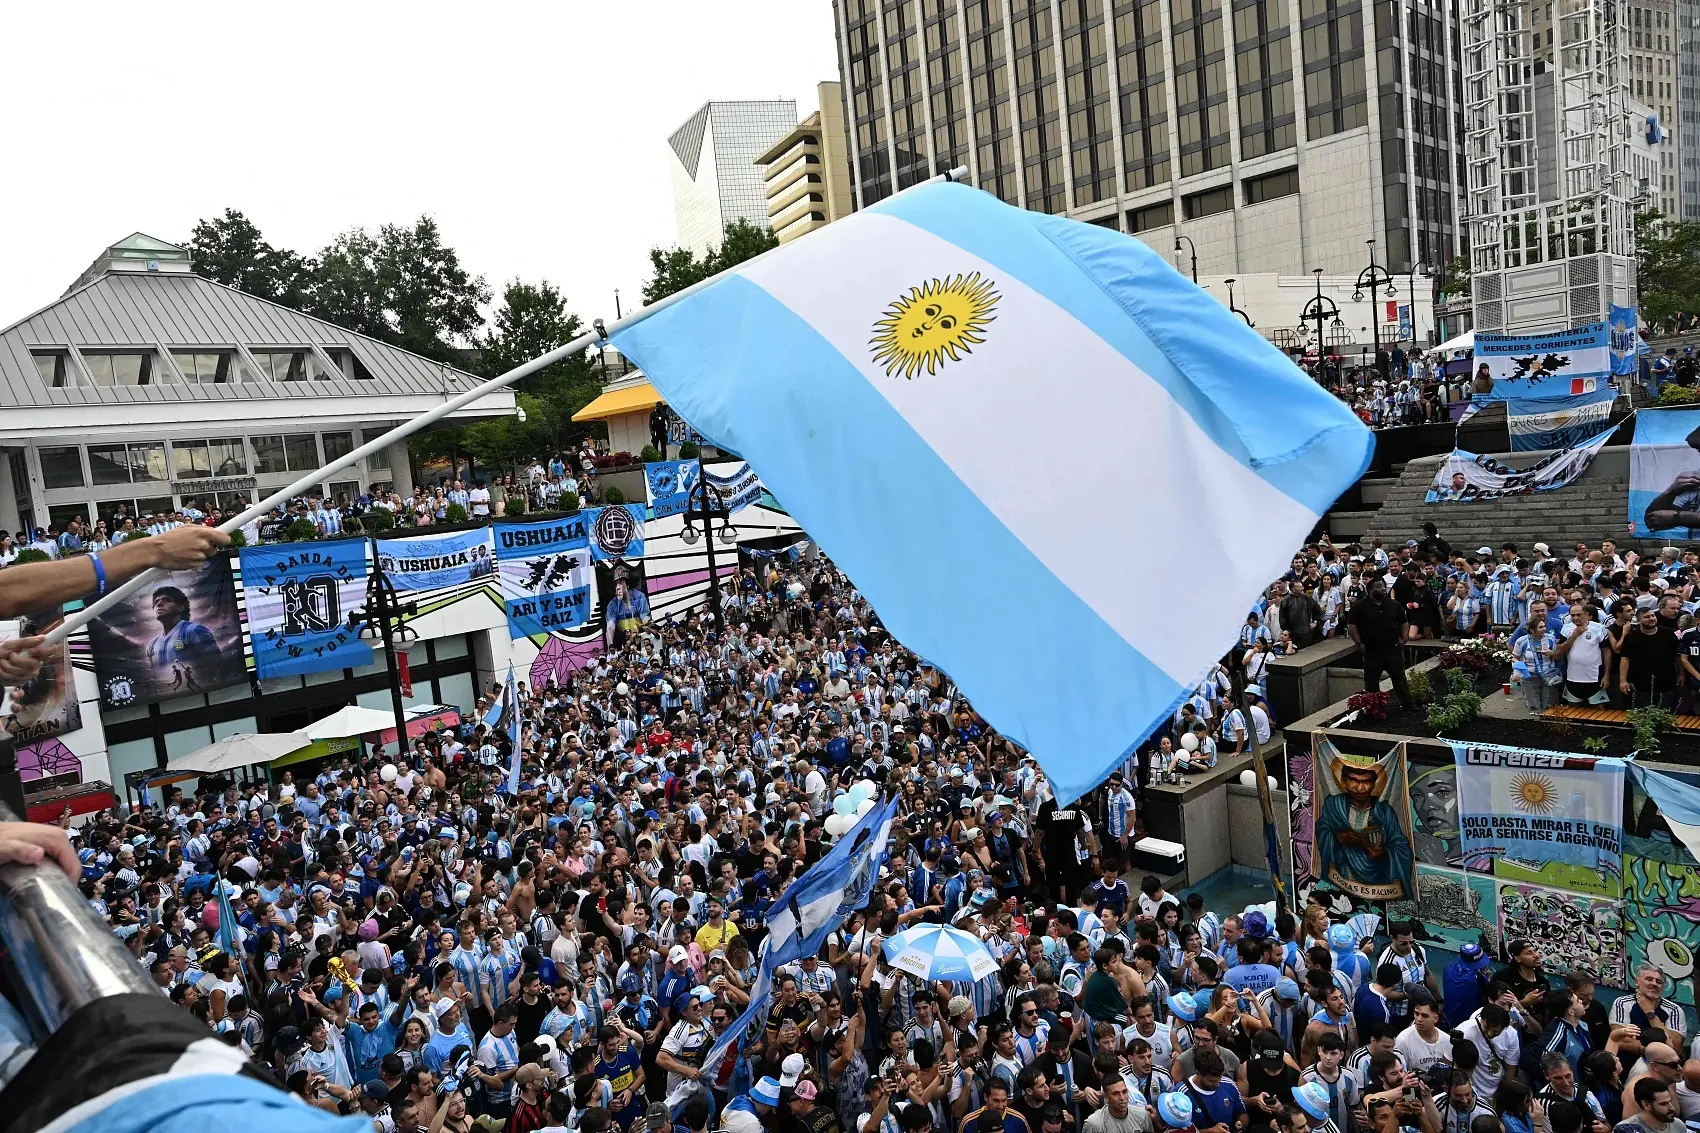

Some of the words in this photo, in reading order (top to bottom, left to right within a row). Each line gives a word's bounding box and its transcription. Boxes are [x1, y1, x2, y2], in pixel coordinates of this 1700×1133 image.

[1483, 344, 1531, 352] MERCEDES
[1534, 337, 1595, 350] CORRIENTES
[501, 522, 587, 548] USHUAIA
[397, 552, 469, 573] USHUAIA
[259, 575, 276, 596] LA
[276, 553, 333, 573] BANDA
[337, 565, 355, 585] DE
[278, 573, 342, 637] 10
[513, 602, 537, 618] ARI
[539, 600, 551, 612] Y
[541, 610, 573, 627] SAIZ
[265, 628, 304, 657] NEW
[1690, 646, 1700, 656] 10
[12, 718, 60, 744] ITÁN
[1467, 746, 1566, 769] Lorenzo
[1051, 810, 1076, 820] SECURITY
[1461, 816, 1488, 829] SOLO
[1491, 816, 1528, 829] BASTA
[1531, 818, 1572, 833] MIRAR
[1576, 823, 1590, 835] EL
[1593, 824, 1619, 842] CIEL
[1465, 828, 1493, 840] PARA
[1496, 828, 1553, 842] SENTIRSE
[1360, 886, 1370, 895] ES
[1371, 887, 1399, 896] RACING
[745, 918, 756, 928] 10
[899, 956, 926, 971] ARGENTINA
[1244, 974, 1269, 982] kanji
